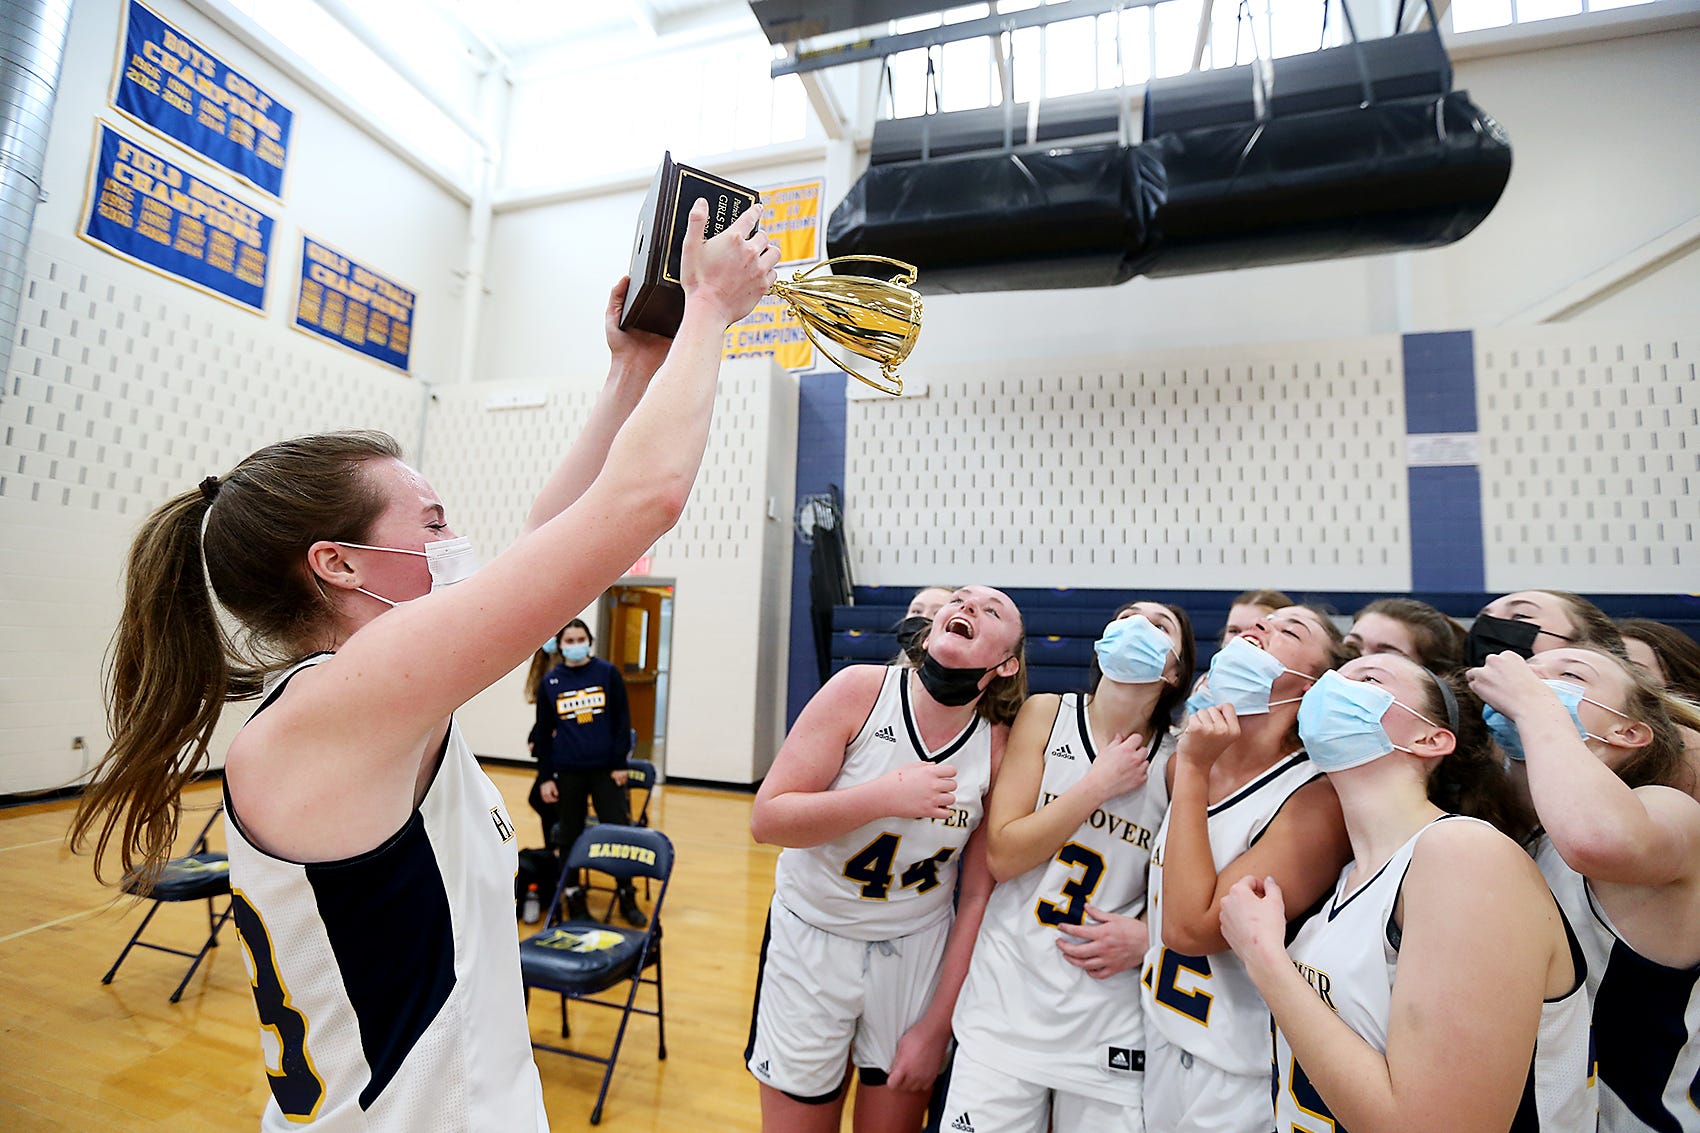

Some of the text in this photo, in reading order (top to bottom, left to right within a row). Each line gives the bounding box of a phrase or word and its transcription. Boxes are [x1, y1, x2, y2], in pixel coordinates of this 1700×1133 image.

[163, 29, 216, 78] BOYS
[143, 40, 282, 141] CHAMPIONS
[113, 161, 262, 248] CHAMPIONS
[117, 140, 183, 188] FIELD
[189, 178, 263, 230] HOCKEY
[716, 194, 729, 223] GIRLS
[738, 325, 807, 347] CHAMPIONS
[875, 731, 897, 743] adidas
[1051, 750, 1076, 761] adidas
[588, 843, 657, 866] HANOVER
[842, 831, 960, 902] 44
[1034, 840, 1107, 928] 3
